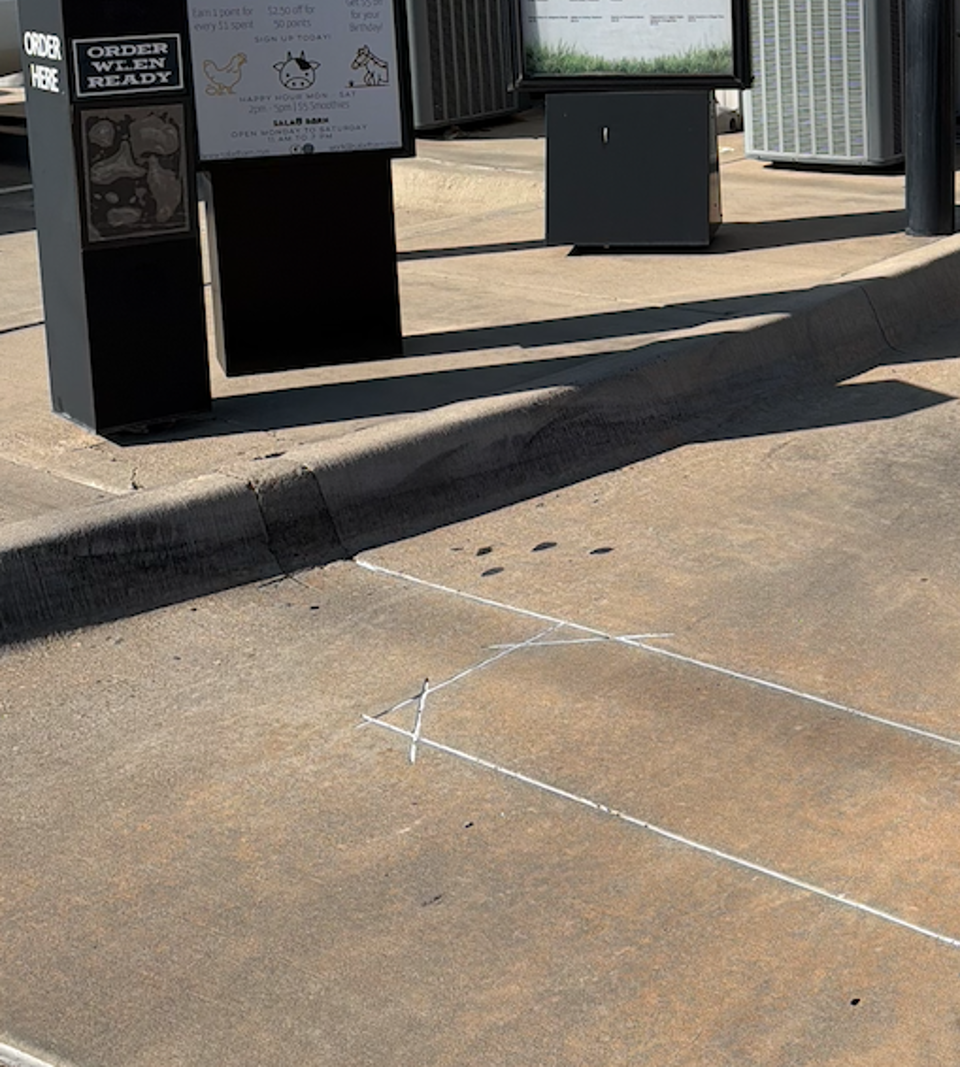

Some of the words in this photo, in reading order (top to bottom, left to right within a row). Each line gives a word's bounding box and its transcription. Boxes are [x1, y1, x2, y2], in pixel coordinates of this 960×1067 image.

[24, 31, 62, 61] ORDER
[87, 42, 169, 59] ORDER
[29, 64, 60, 93] HERE
[87, 71, 172, 89] READY
